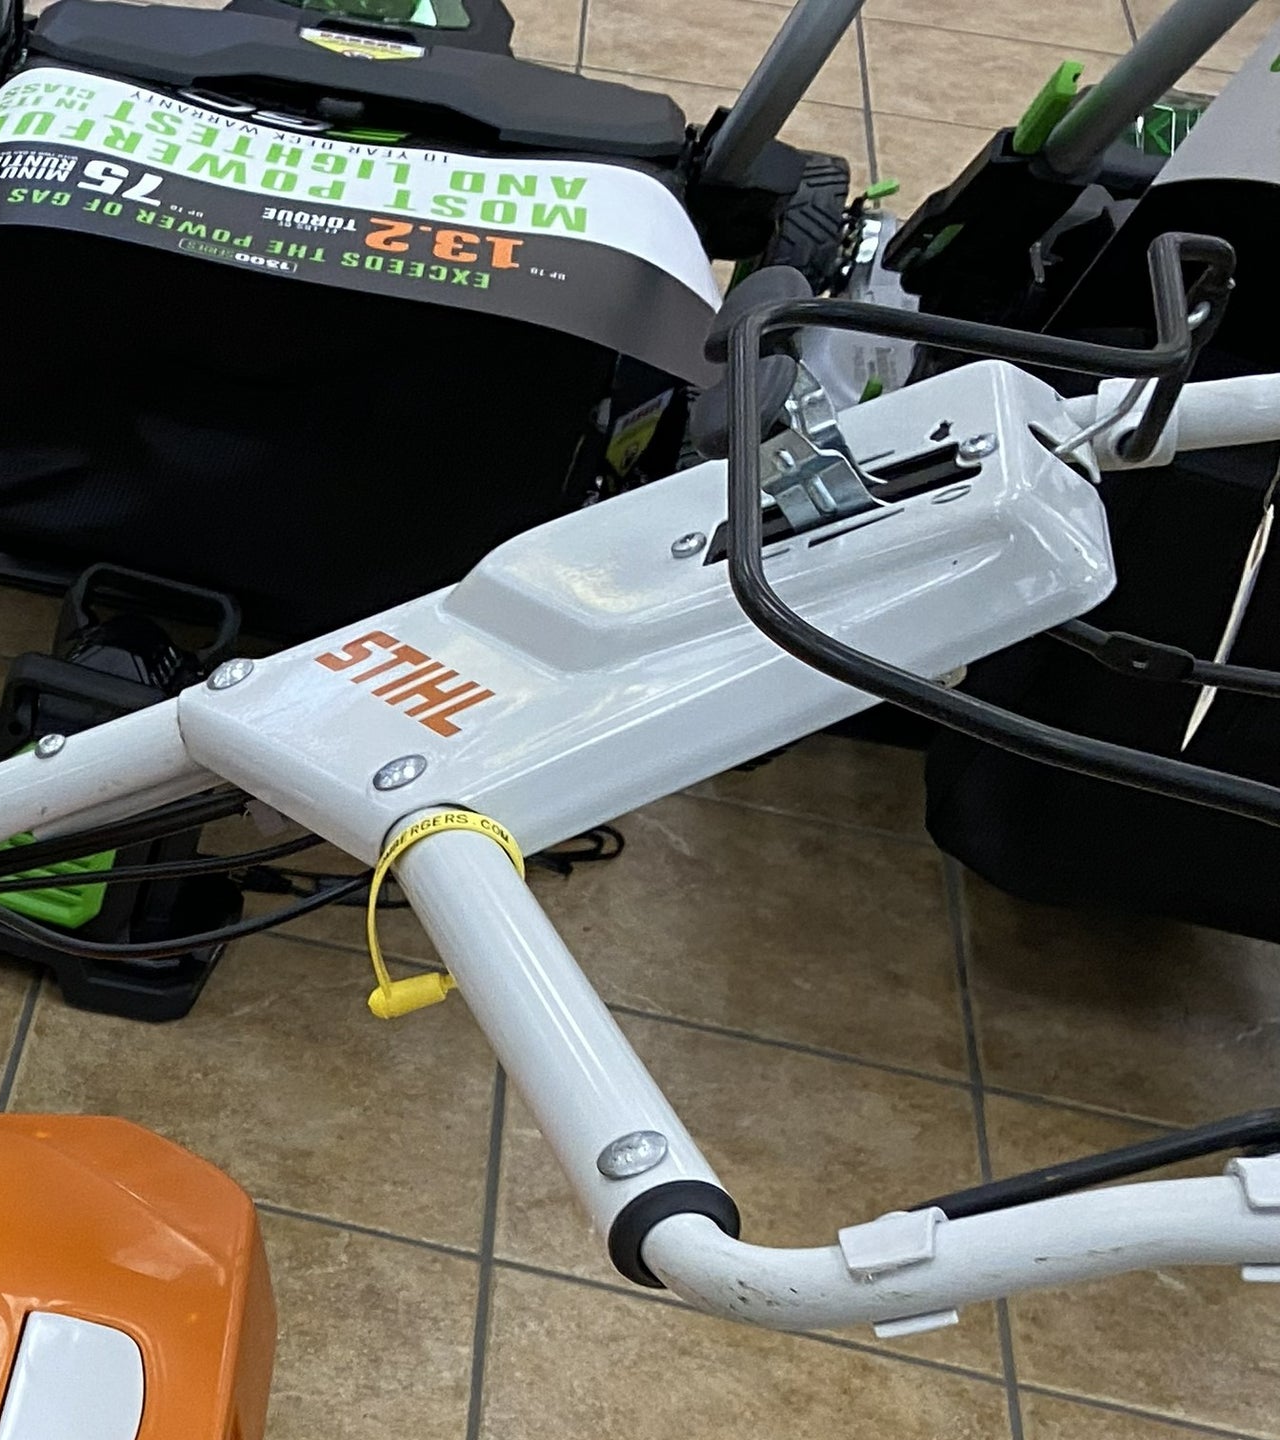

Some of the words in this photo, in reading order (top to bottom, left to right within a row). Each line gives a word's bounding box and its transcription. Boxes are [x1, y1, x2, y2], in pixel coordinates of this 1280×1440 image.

[4, 82, 97, 100] CLASS
[54, 98, 90, 113] IN
[129, 90, 259, 136] WARRANTY
[103, 99, 411, 185] LIGHTEST
[274, 131, 334, 150] DECK
[349, 144, 409, 160] YEAR
[424, 153, 449, 164] 10
[76, 159, 164, 207] 75
[449, 170, 588, 200] AND
[6, 187, 73, 207] GAS
[82, 197, 124, 217] OF
[261, 206, 357, 232] TORQUE
[383, 188, 588, 233] MOST
[135, 208, 254, 249] POWER
[266, 239, 327, 263] THE
[364, 217, 525, 270] 13.2
[340, 251, 490, 290] EXCEEDS
[549, 270, 566, 281] UP
[313, 629, 496, 738] STIHL
